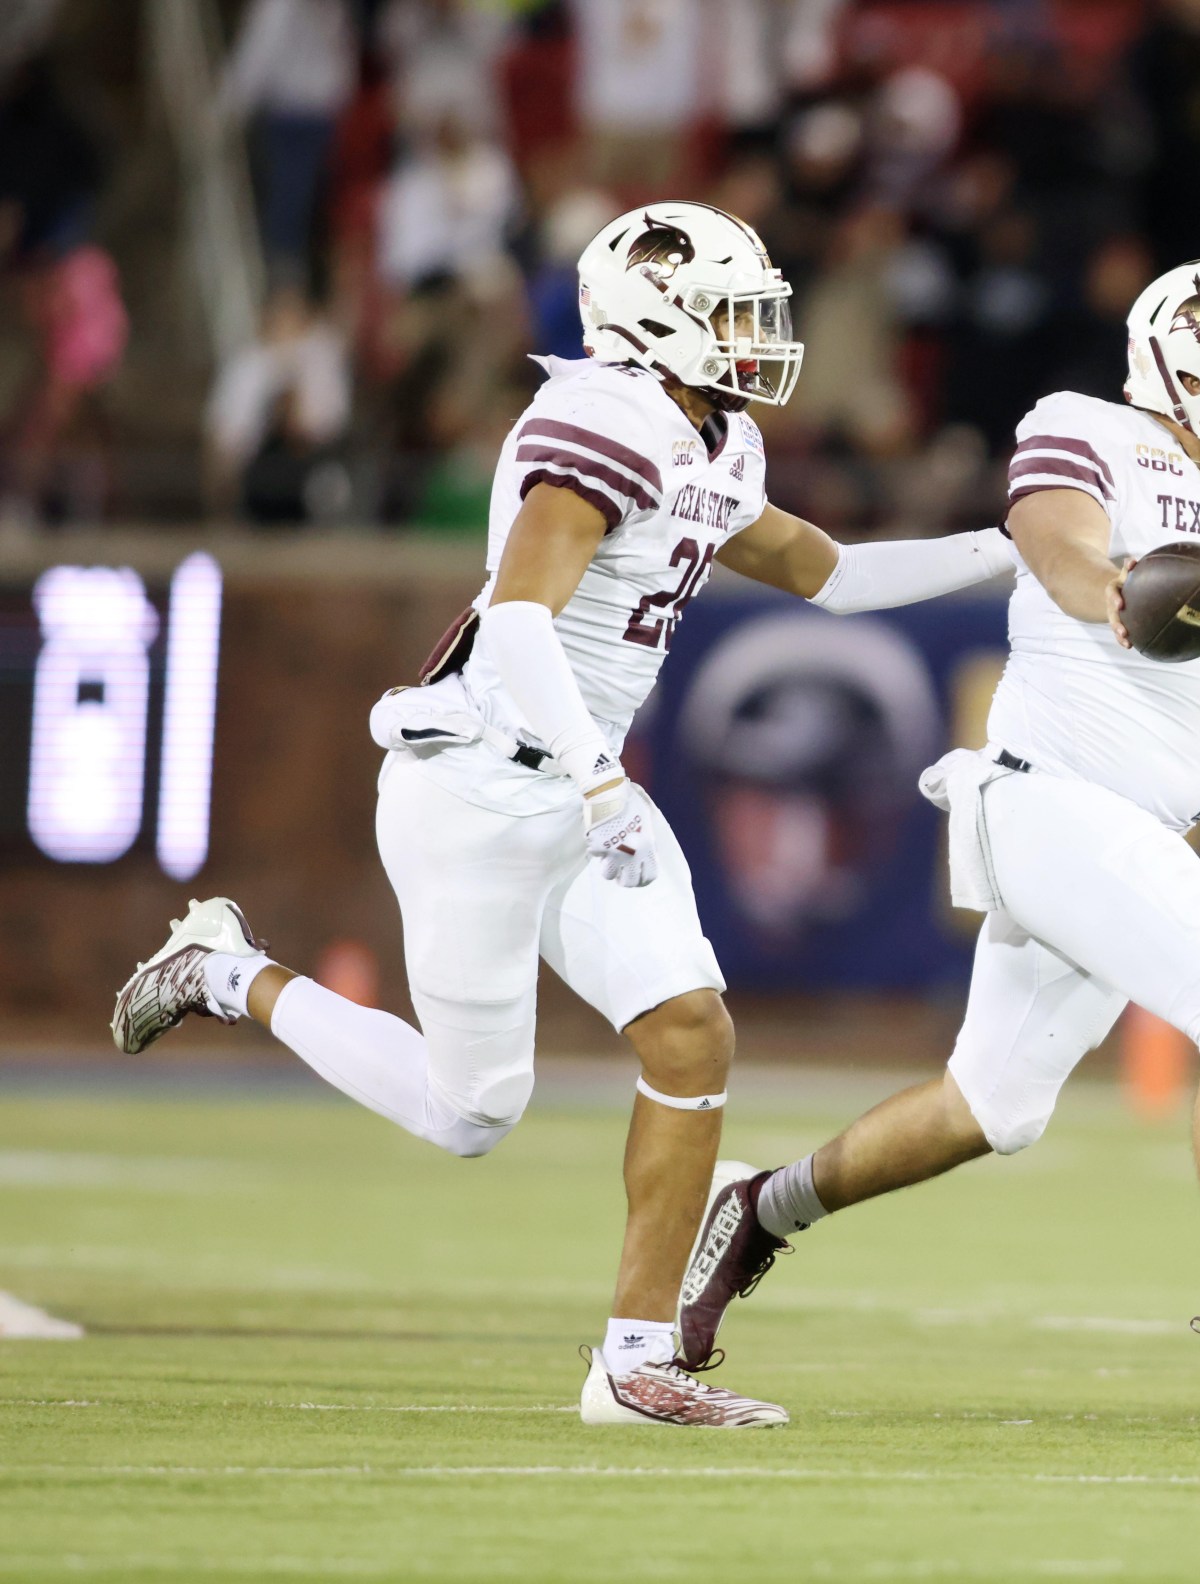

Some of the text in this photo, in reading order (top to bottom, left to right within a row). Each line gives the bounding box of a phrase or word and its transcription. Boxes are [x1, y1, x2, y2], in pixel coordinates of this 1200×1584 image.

[1136, 444, 1183, 476] SBC
[671, 483, 740, 533] TEXAS STATE
[603, 815, 642, 850] adidas
